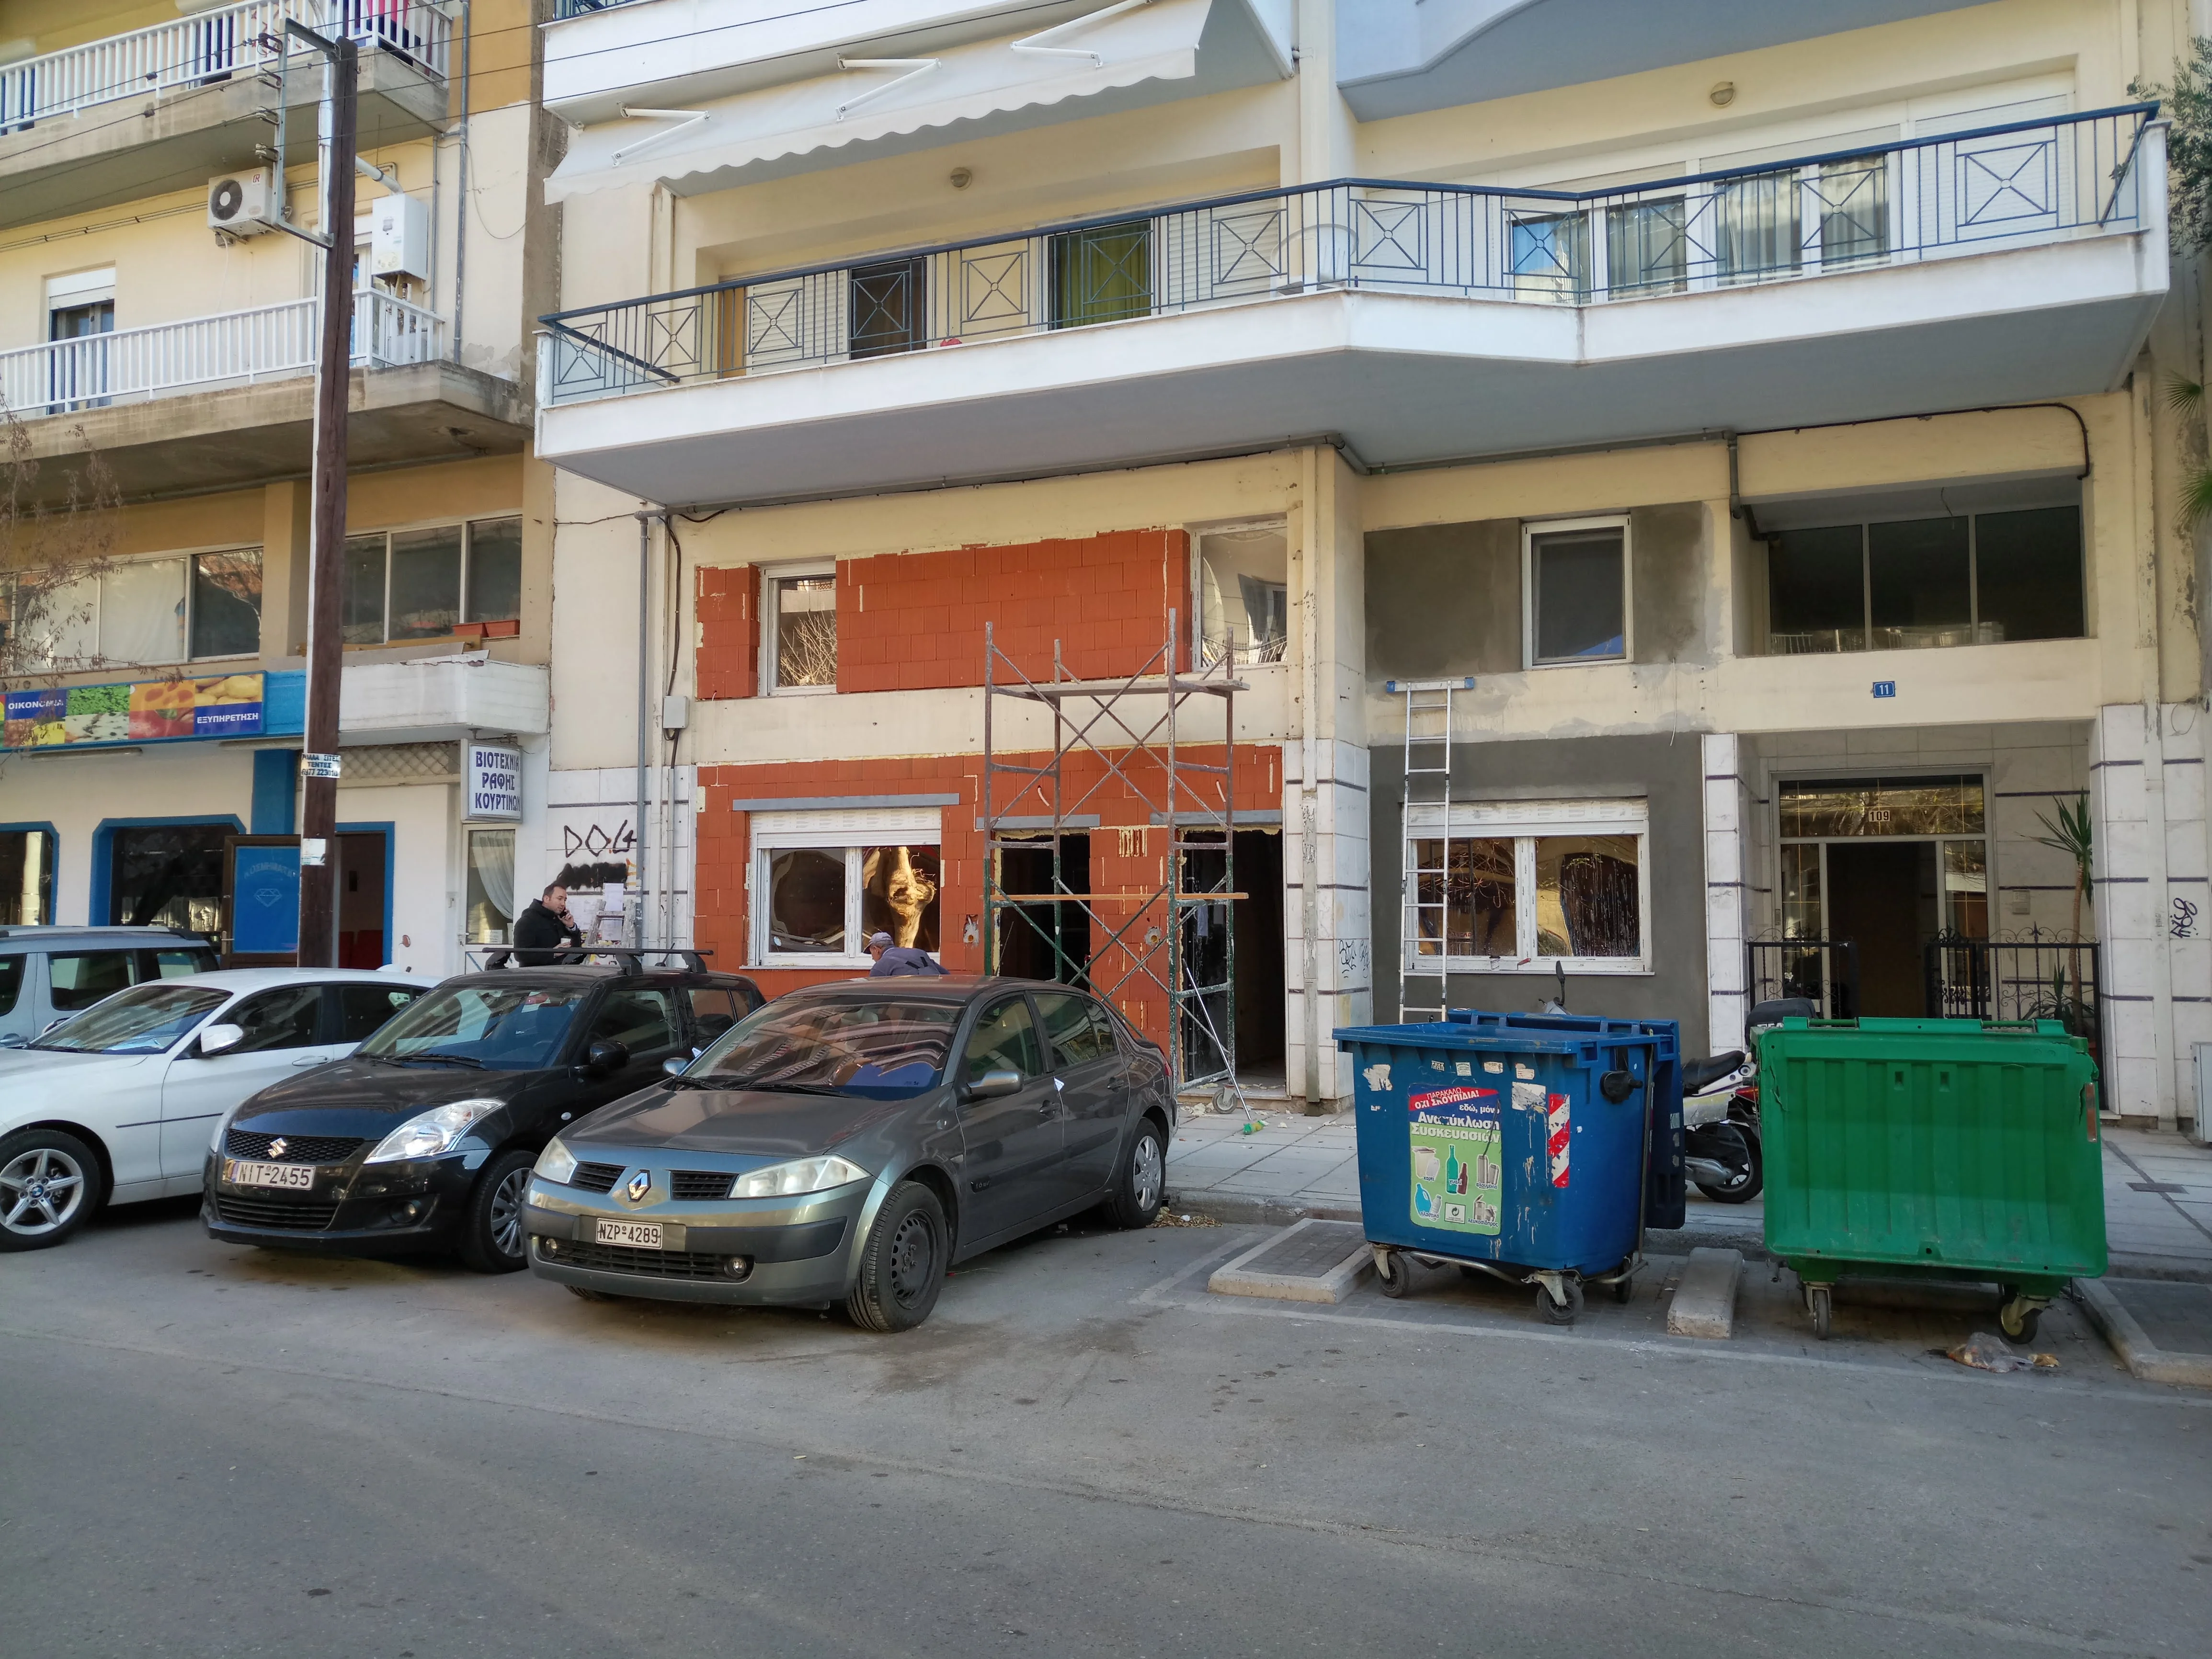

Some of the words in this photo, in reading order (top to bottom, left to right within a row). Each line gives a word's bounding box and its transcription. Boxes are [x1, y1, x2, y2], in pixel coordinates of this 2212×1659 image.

[1879, 684, 1889, 695] 11
[197, 713, 259, 724] ΕΞΥΠΗΡΕΤΗΣΗ
[476, 751, 519, 772] ΒΙΟΤΕΧΝΙΑ
[482, 772, 515, 791] ΡΑΦΗΣ
[475, 793, 521, 811] ΚΟΥΡΤΙΝΩΝ
[1870, 811, 1889, 821] 109
[1415, 1101, 1429, 1109] ΟΧΙ
[1411, 1123, 1500, 1143] Συσκευασιών
